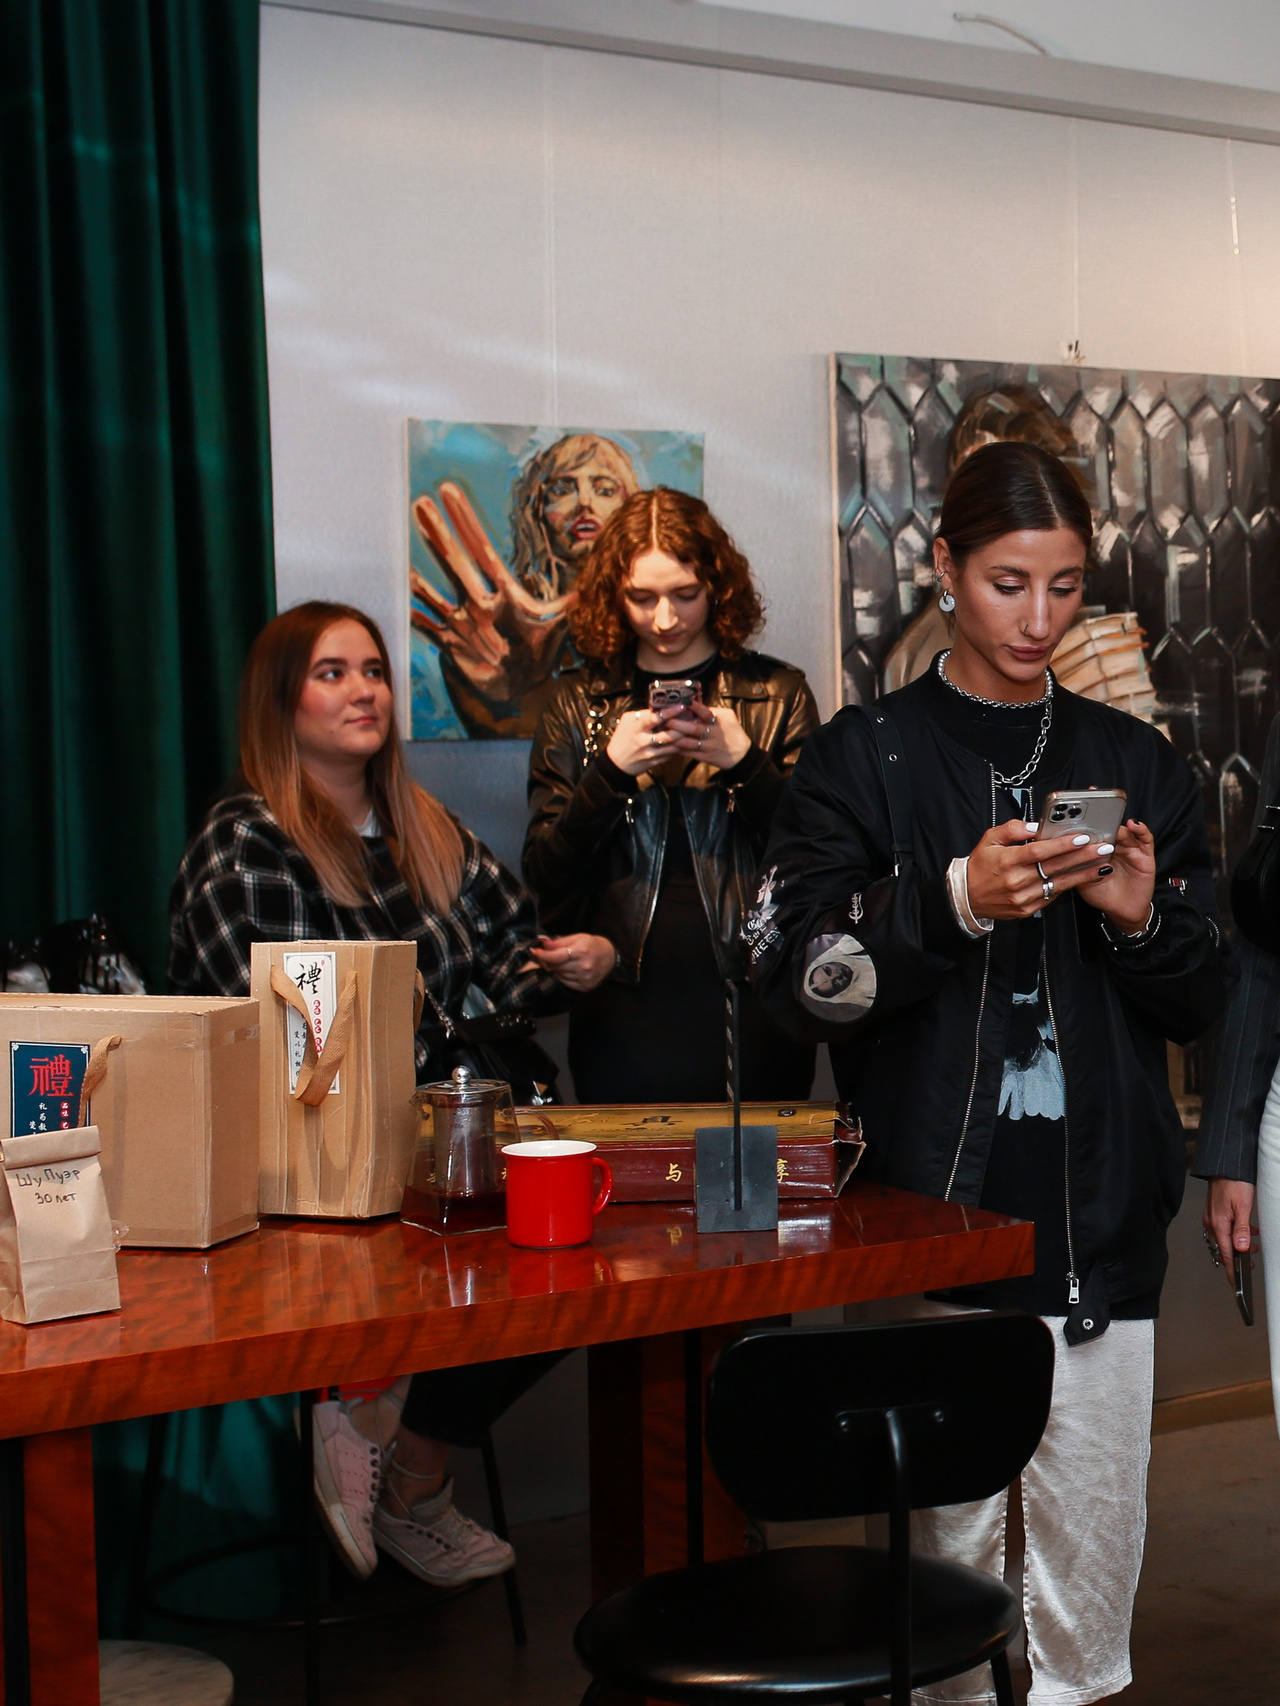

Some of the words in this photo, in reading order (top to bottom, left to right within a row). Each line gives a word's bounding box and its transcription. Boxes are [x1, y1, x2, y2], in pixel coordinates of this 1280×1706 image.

[294, 961, 322, 995] 禮
[27, 1053, 74, 1097] 禮
[15, 1173, 42, 1188] Шу
[44, 1168, 80, 1185] Пуэр
[665, 1162, 682, 1182] 与
[34, 1192, 53, 1205] 30
[55, 1192, 77, 1204] лет
